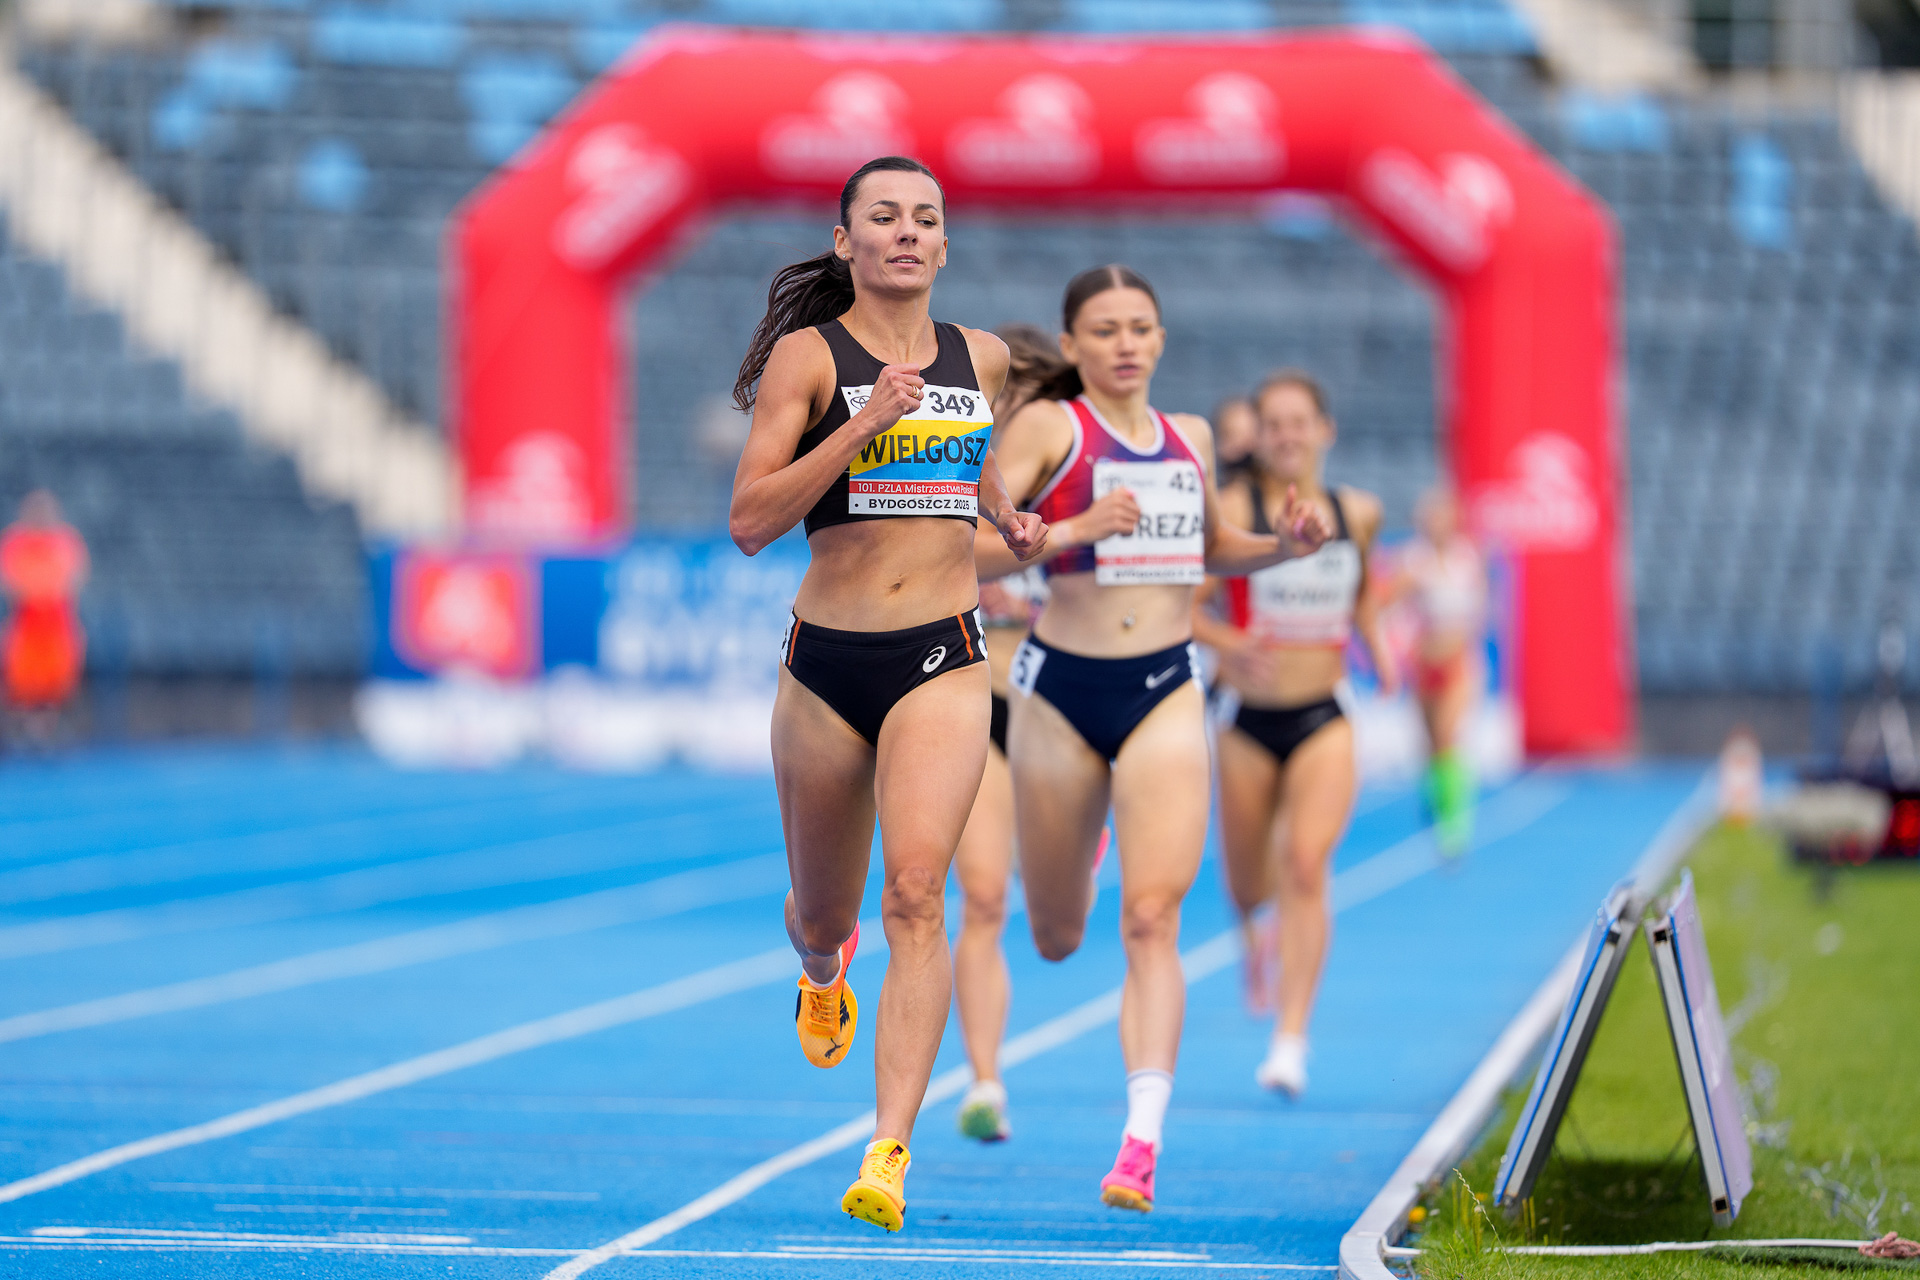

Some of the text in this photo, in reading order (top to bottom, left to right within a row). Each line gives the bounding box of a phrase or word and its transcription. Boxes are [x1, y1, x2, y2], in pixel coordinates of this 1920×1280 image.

[928, 391, 975, 416] 349
[861, 434, 986, 467] WIELGOSZ
[858, 483, 876, 493] 101.
[878, 483, 902, 493] PZLA
[905, 483, 960, 494] Mistrzostwa
[868, 498, 970, 510] BYDGOSZCZ 2025
[1120, 513, 1204, 538] REZA
